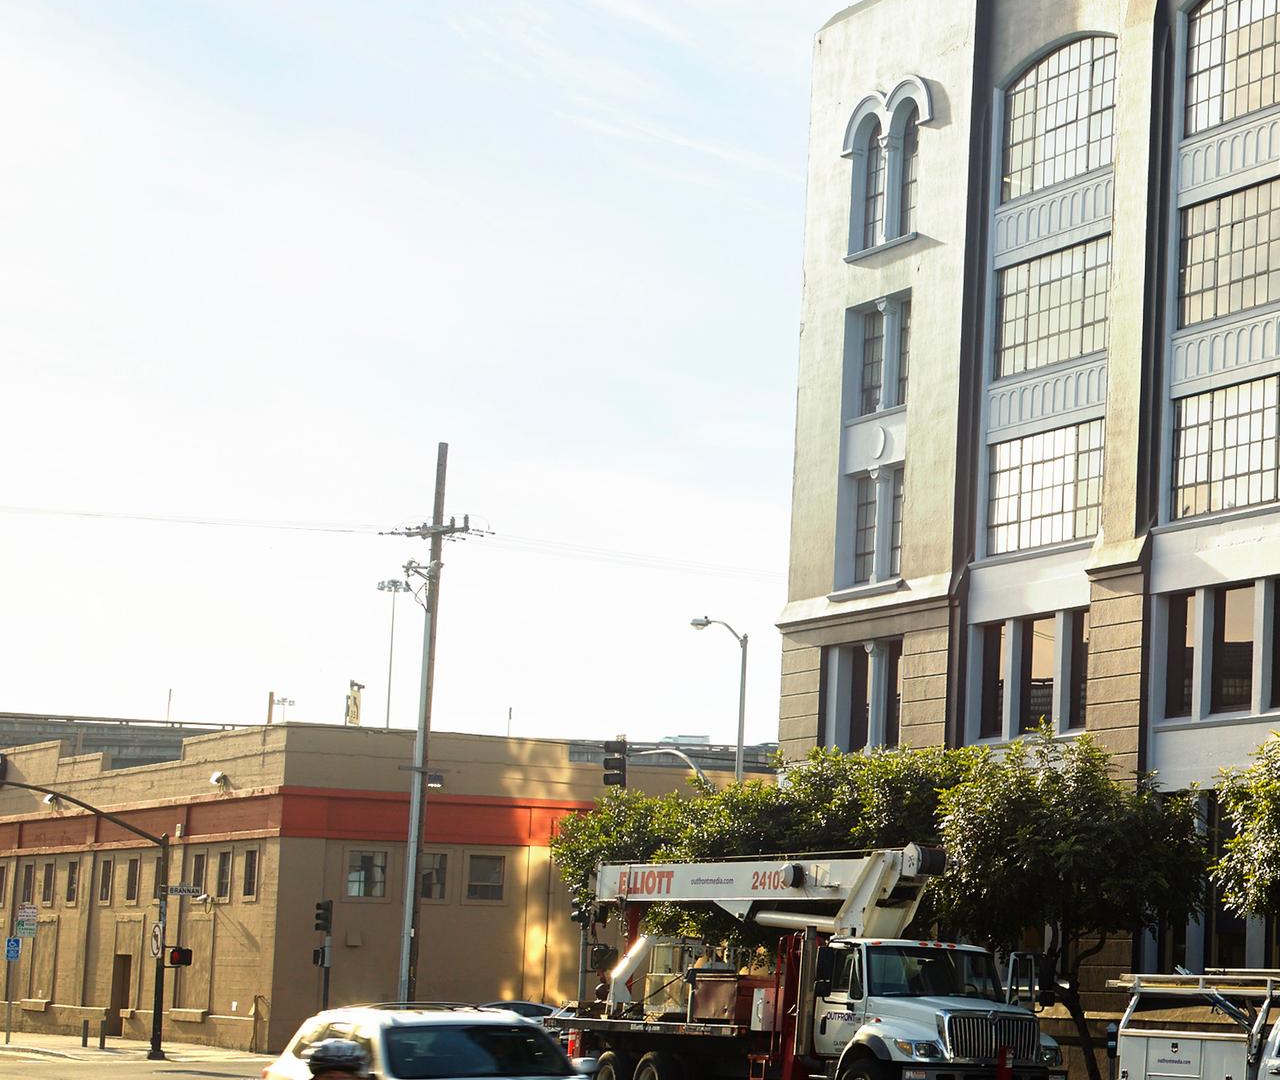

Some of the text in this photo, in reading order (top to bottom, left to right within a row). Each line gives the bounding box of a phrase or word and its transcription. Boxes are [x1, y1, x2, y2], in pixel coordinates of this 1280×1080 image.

[618, 870, 674, 895] ELLIOTT
[690, 876, 734, 886] outfrontmedia.com
[826, 1012, 857, 1022] OUTFRONT
